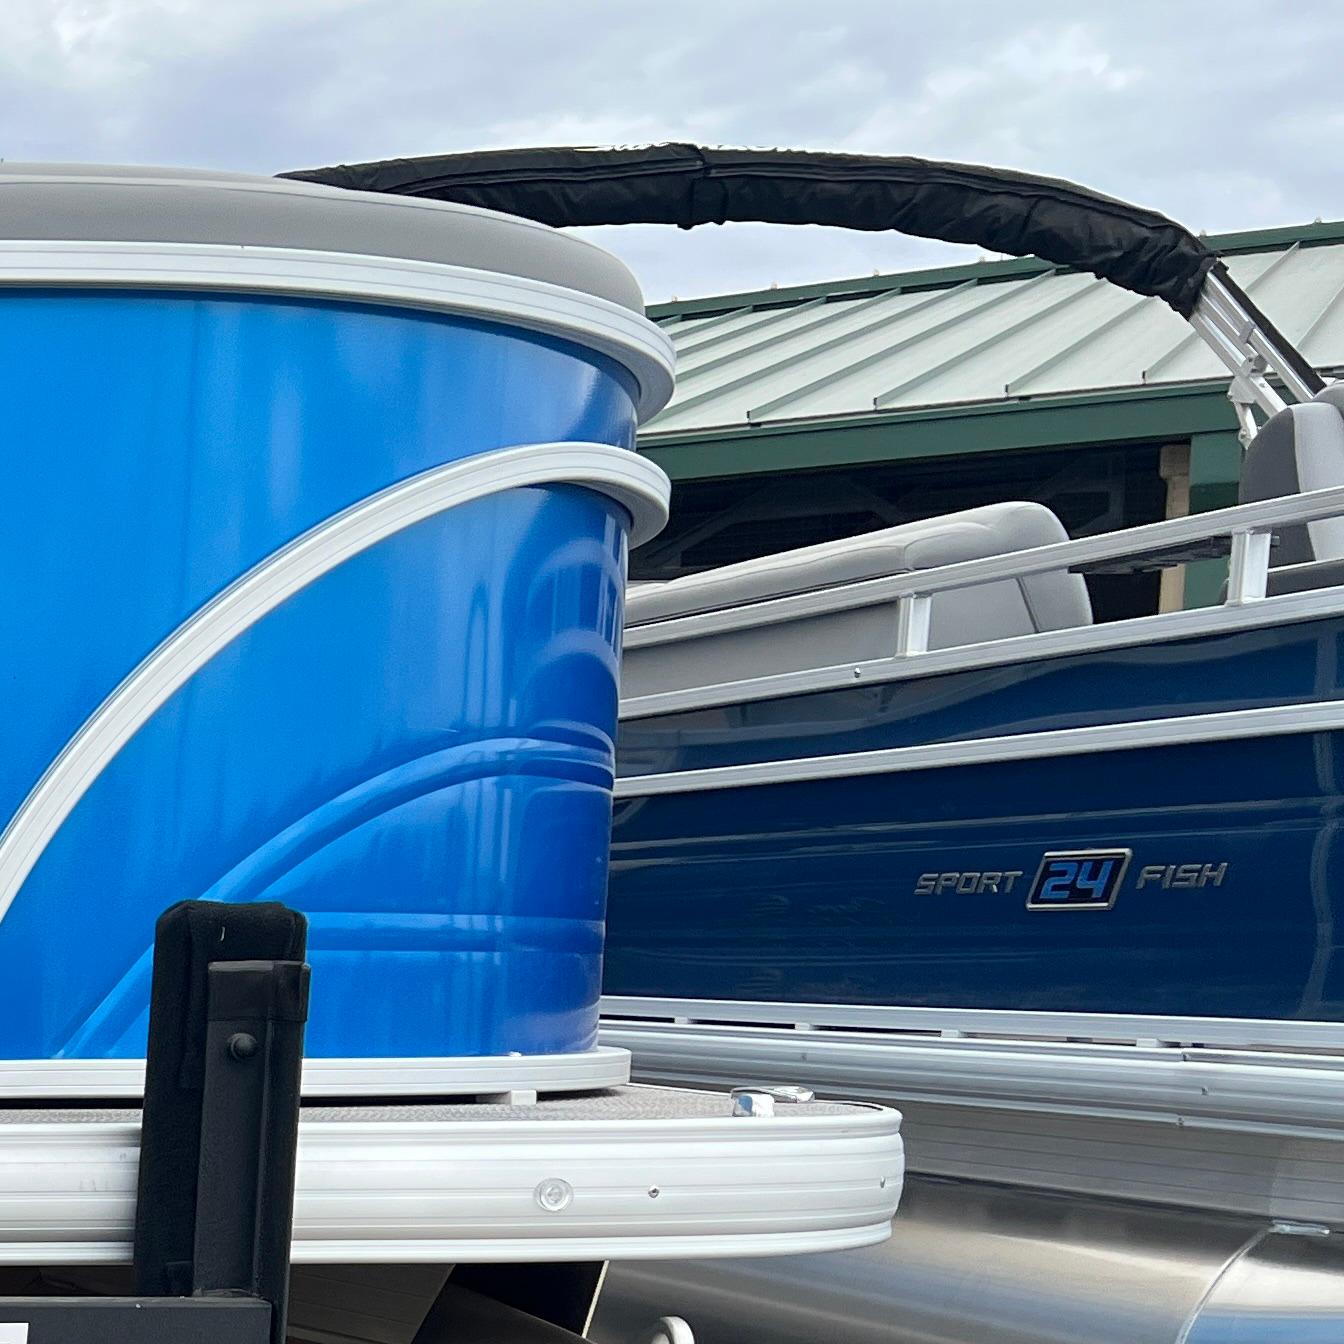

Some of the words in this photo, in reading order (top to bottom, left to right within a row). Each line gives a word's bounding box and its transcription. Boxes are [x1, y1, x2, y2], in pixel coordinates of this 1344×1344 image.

[913, 870, 1023, 895] SPORT
[1039, 860, 1114, 899] 24
[1135, 862, 1228, 890] FISH
